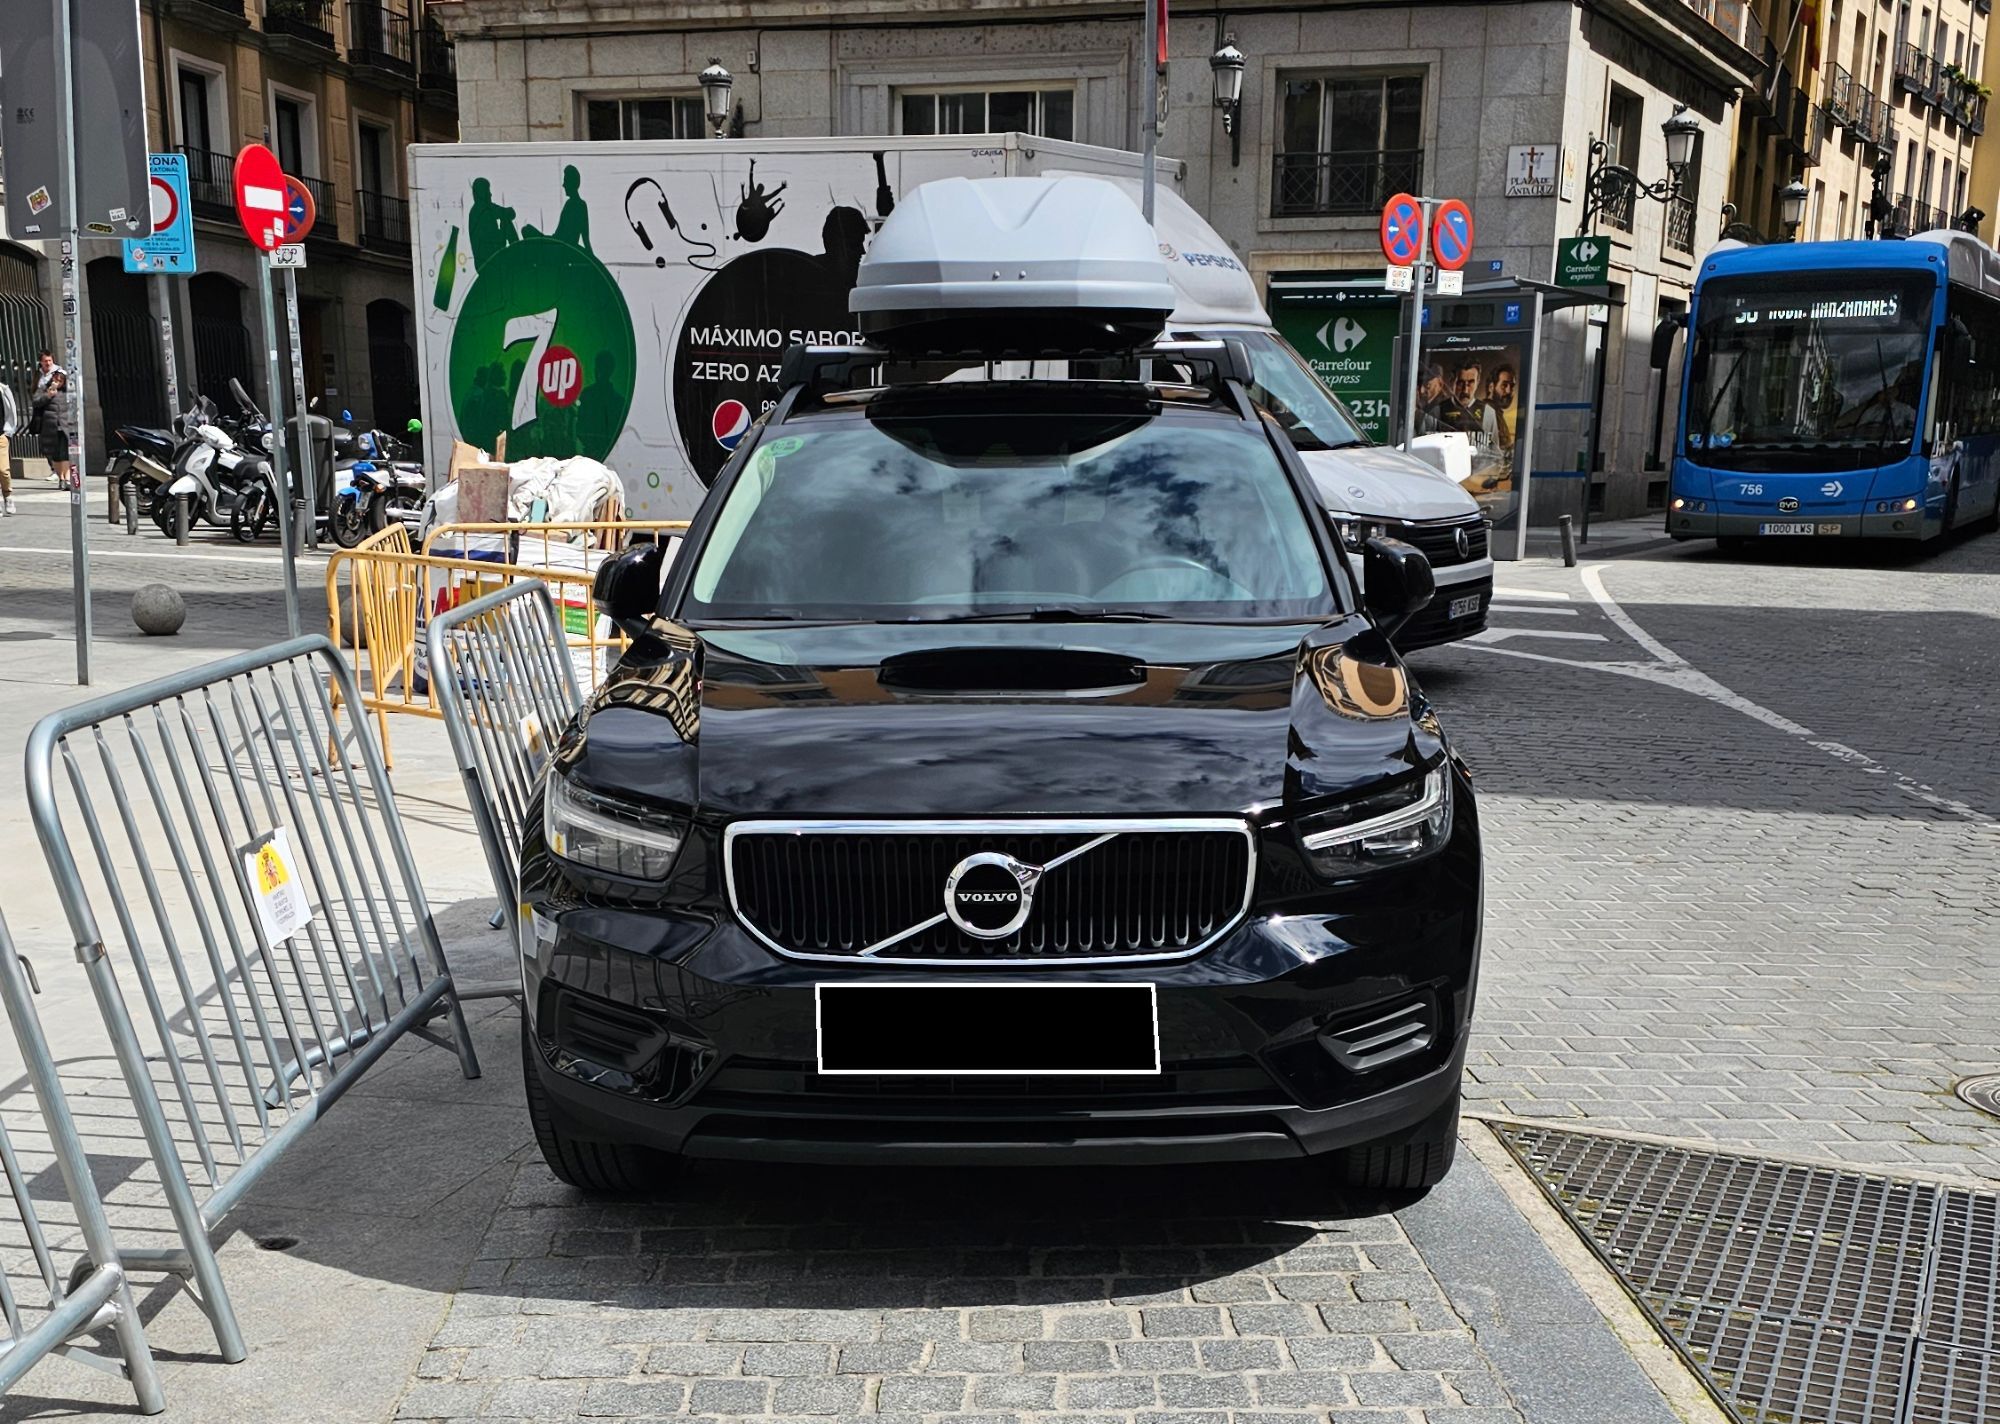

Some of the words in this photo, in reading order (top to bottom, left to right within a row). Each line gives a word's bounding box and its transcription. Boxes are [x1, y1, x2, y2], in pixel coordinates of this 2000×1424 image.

[690, 324, 782, 347] MÁXIMO
[503, 308, 557, 430] 7
[1309, 359, 1371, 371] Carrefour
[692, 362, 749, 381] ZERO
[1740, 484, 1763, 495] 756
[1768, 524, 1791, 533] 1000
[1793, 524, 1812, 533] LWS
[957, 893, 1018, 902] VOLVO
